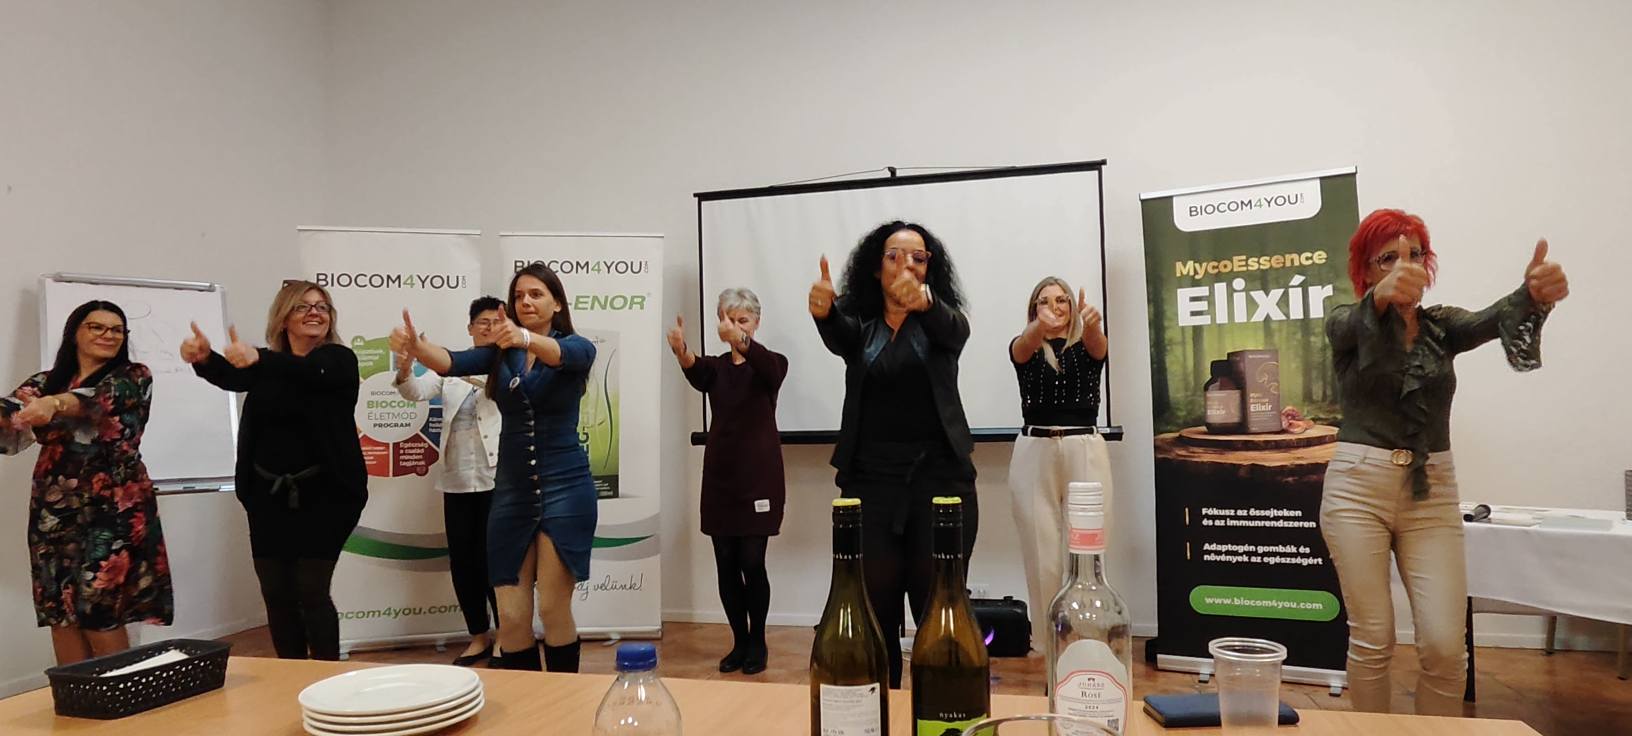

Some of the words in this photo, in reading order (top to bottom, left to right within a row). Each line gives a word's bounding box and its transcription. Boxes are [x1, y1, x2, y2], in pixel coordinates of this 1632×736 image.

[1189, 192, 1299, 217] BIOCOM4YOU
[1175, 250, 1328, 279] MycoEssence
[316, 272, 460, 289] BIOCOM4YOU
[569, 295, 646, 311] -ENOR
[1177, 274, 1334, 327] Elixír
[367, 400, 417, 409] BIOCOM
[1202, 508, 1235, 516] Fókusz
[1202, 518, 1213, 526] és
[1226, 518, 1317, 528] immunrendszeren
[1203, 543, 1256, 553] Adaptogén
[1257, 544, 1297, 554] gombák
[1299, 545, 1311, 554] és
[1203, 554, 1249, 563] növények
[1250, 555, 1262, 563] az
[1263, 555, 1323, 566] egészségért
[594, 572, 644, 592] velünk!
[1204, 596, 1323, 610] www.biocom4you.com
[337, 603, 464, 620] ocom4you.com
